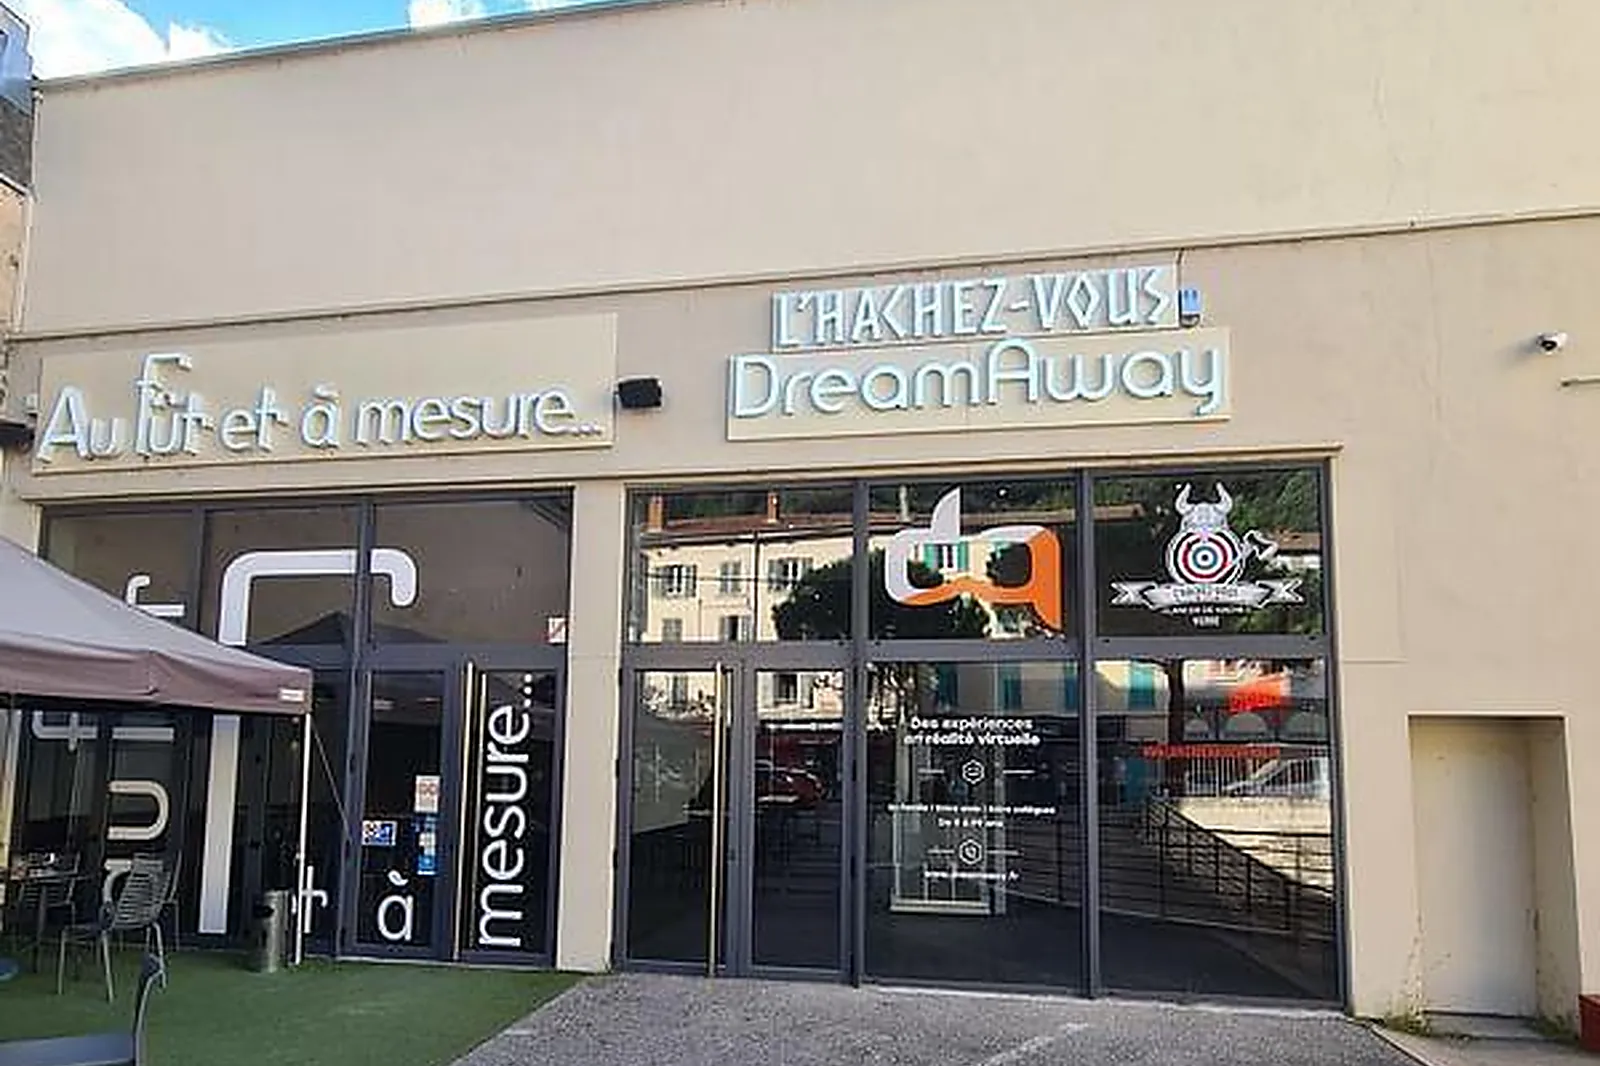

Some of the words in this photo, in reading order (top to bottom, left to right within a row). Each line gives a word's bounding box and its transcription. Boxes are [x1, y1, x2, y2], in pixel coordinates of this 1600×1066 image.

[777, 268, 1171, 347] L'HACHEZ-VOUS
[733, 338, 1221, 418] DreamAway
[36, 385, 122, 463] Au
[221, 386, 290, 452] et
[302, 382, 340, 447] à
